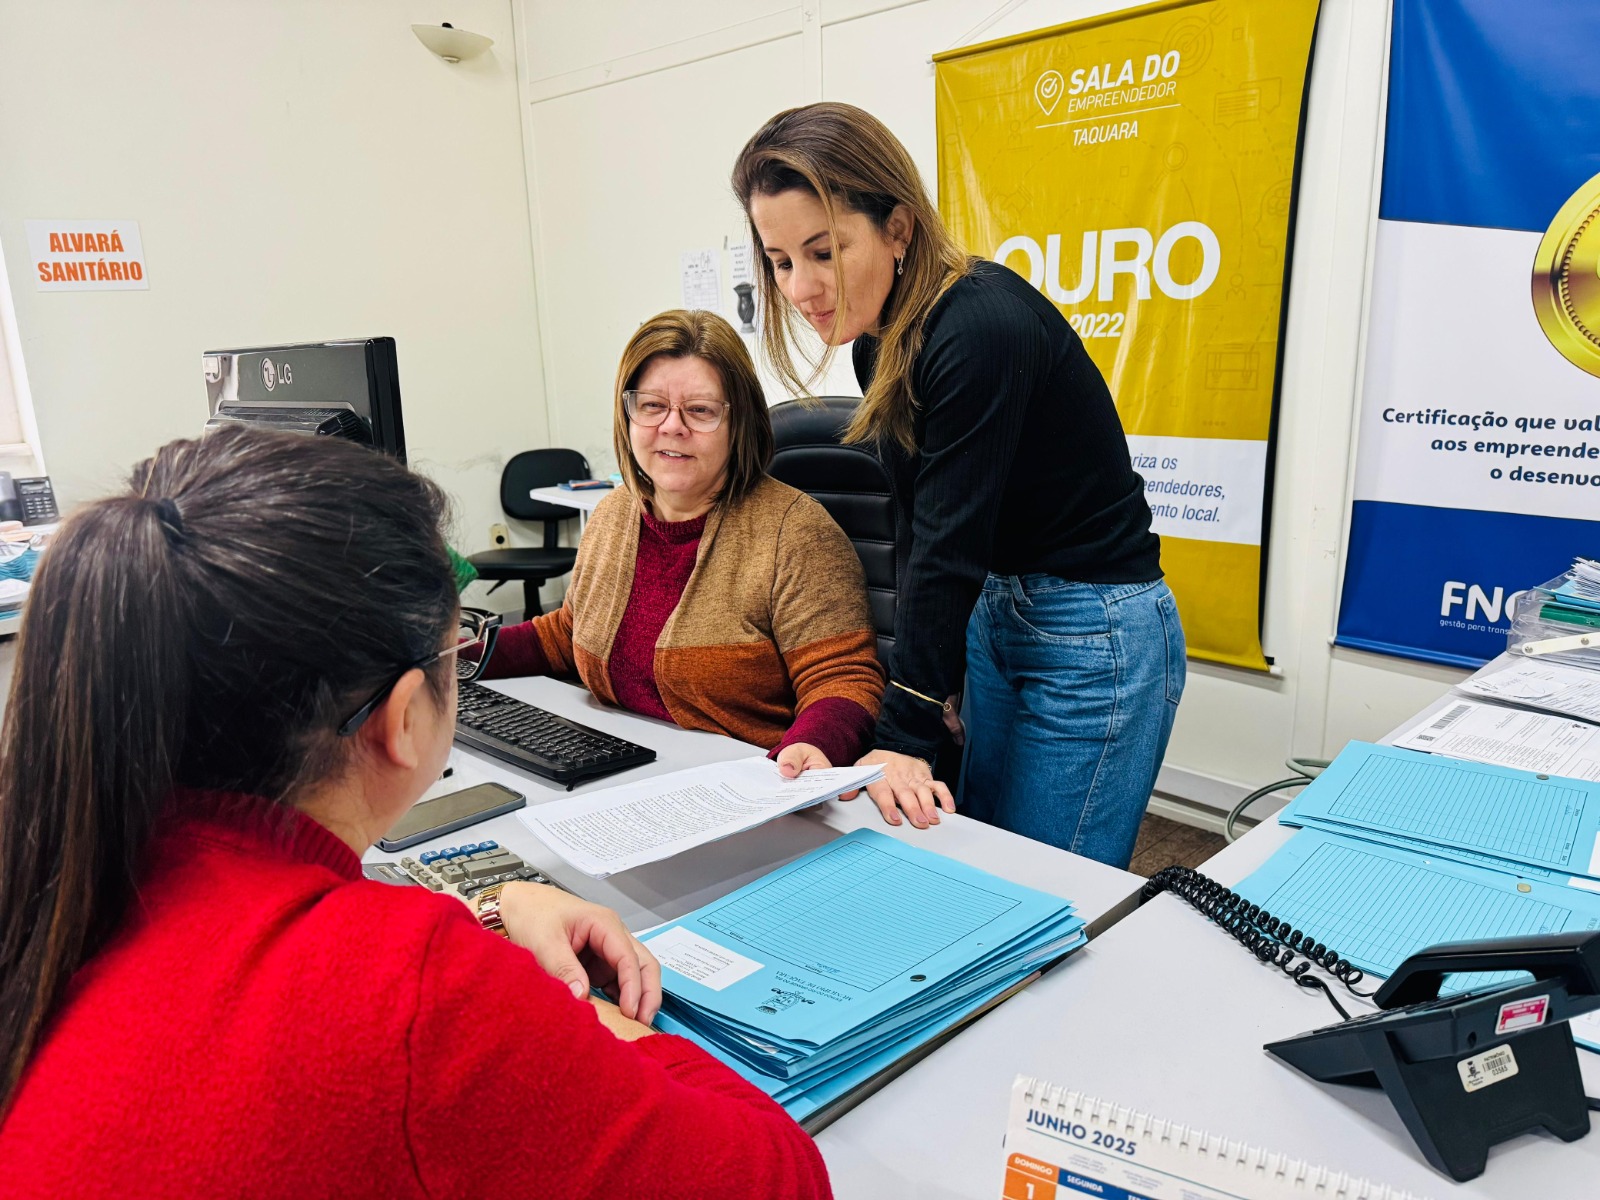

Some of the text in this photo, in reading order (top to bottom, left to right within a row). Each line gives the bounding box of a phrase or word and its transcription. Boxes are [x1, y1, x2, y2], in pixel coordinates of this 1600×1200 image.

[1068, 50, 1180, 95] SALA DO
[1068, 81, 1177, 113] EMPREENDEDOR
[1073, 121, 1138, 146] TAQUARA
[49, 229, 124, 252] ALVARÁ
[37, 258, 143, 282] SANITÁRIO
[1069, 312, 1125, 338] 2022
[276, 363, 292, 385] LG
[1382, 407, 1508, 431] Certificação
[1514, 416, 1556, 433] que
[1431, 438, 1600, 460] aos empreende
[1131, 453, 1178, 470] riza os
[1490, 465, 1600, 487] o desenvo
[1182, 504, 1220, 523] local.
[1439, 618, 1466, 629] gestão
[1467, 623, 1486, 632] para
[1026, 1108, 1137, 1156] JUNHO 2025
[1014, 1156, 1053, 1175] DOMINGO
[1067, 1174, 1104, 1193] SEGUNDA
[1026, 1182, 1034, 1200] 1
